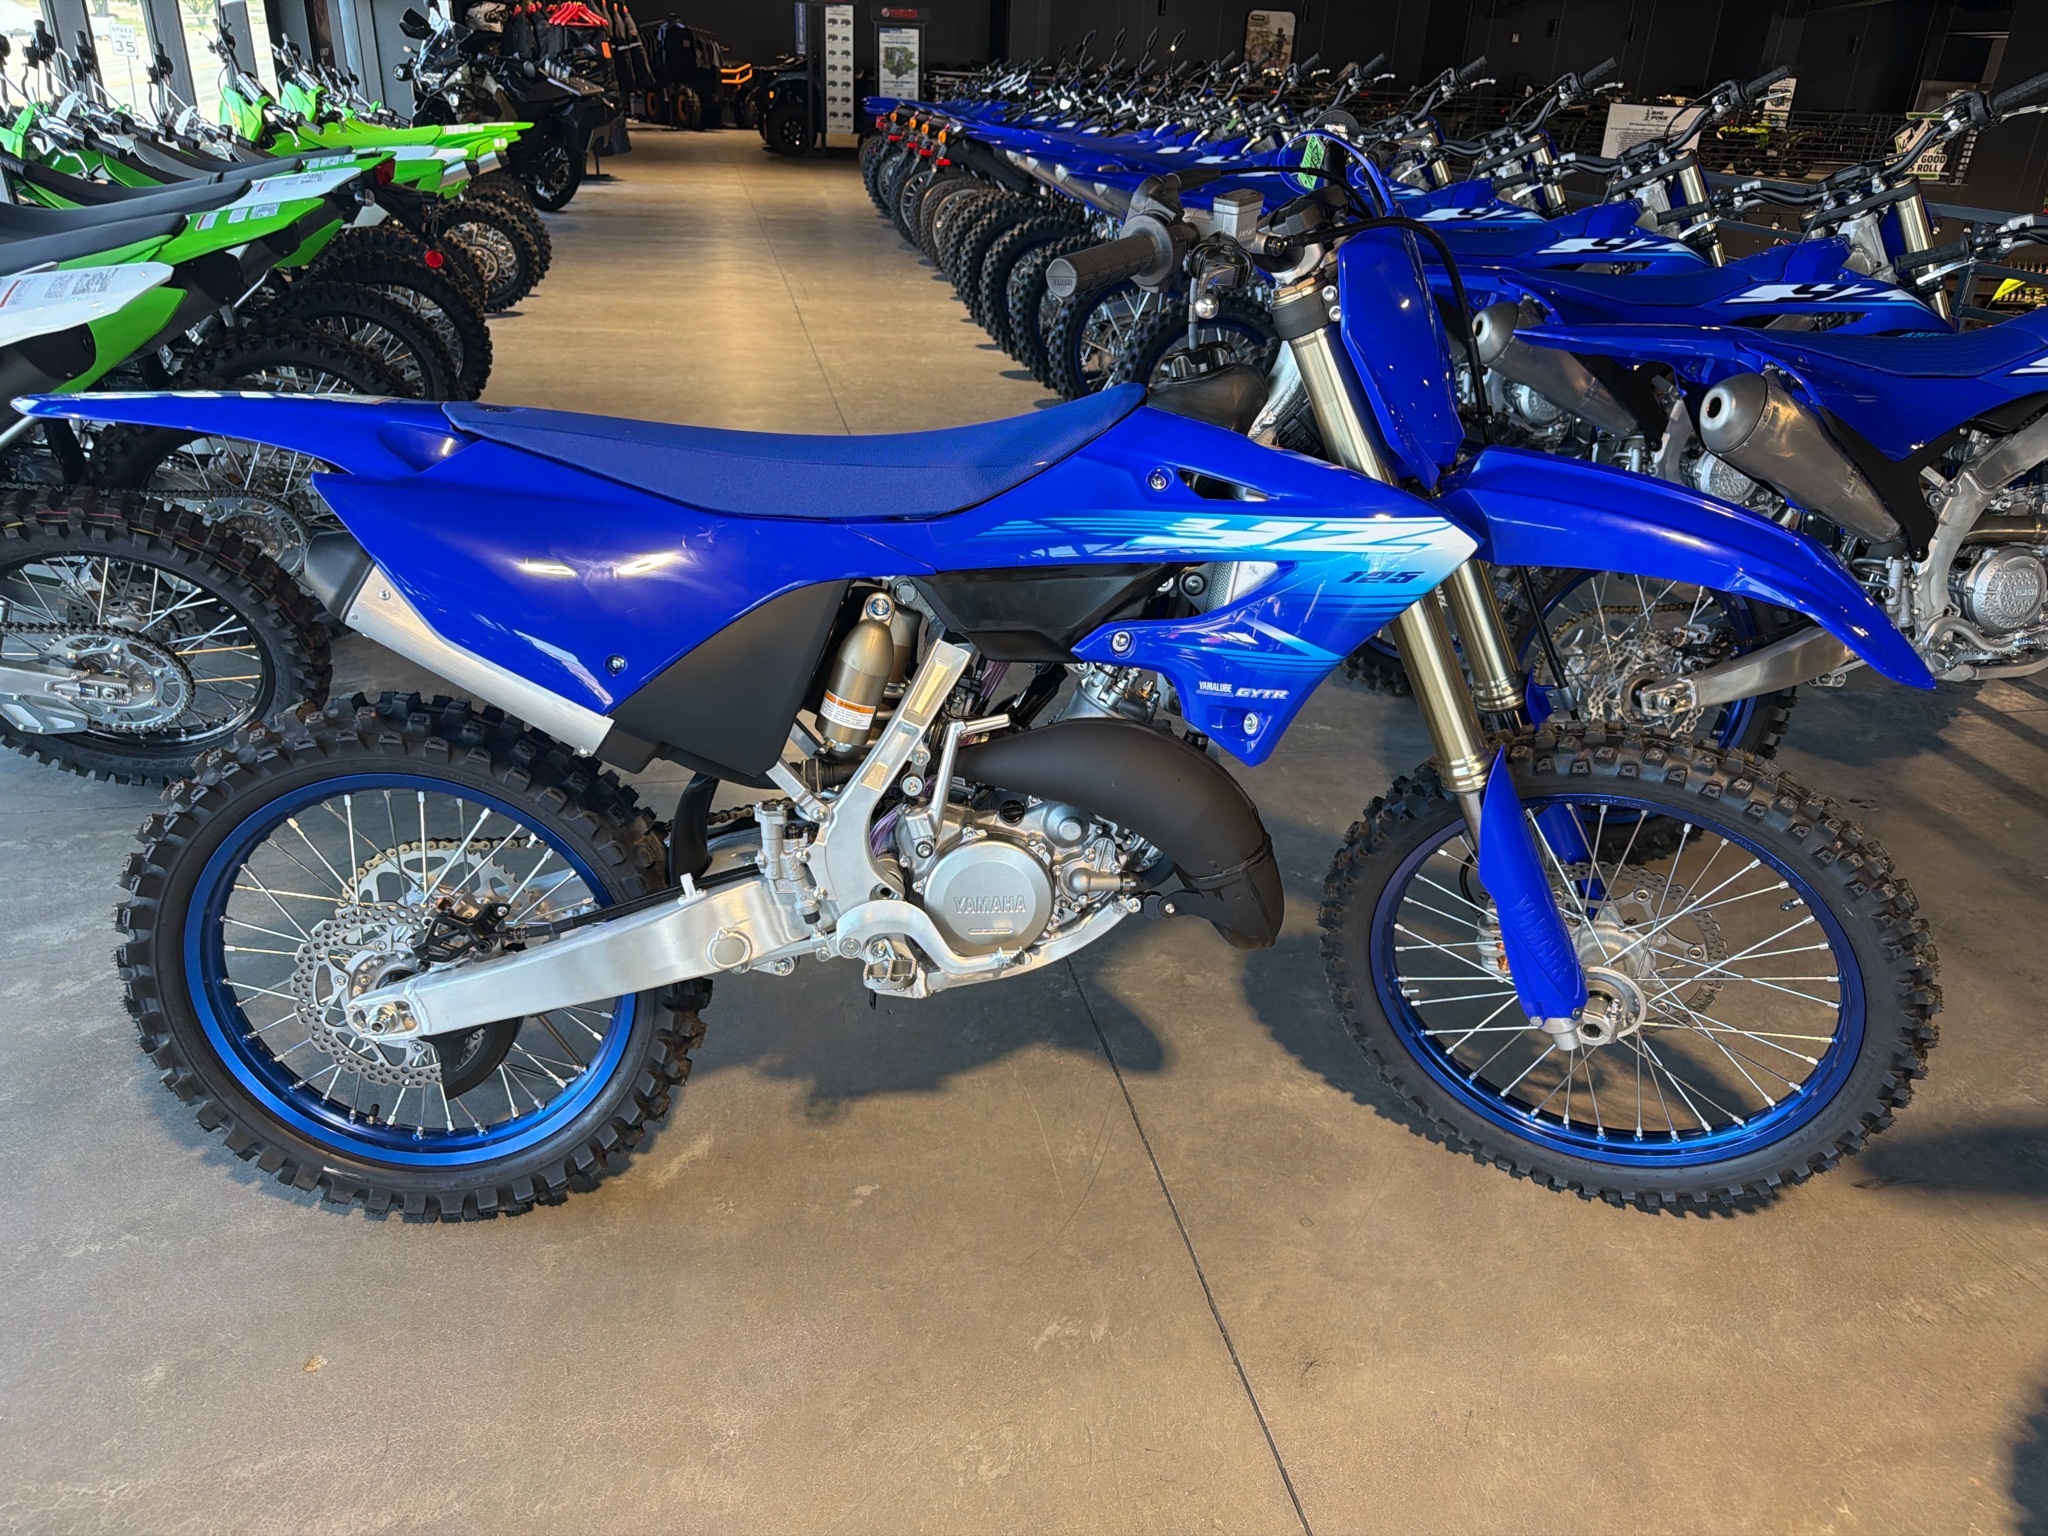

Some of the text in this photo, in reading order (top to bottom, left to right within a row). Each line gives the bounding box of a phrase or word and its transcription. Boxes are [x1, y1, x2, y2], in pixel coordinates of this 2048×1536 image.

[111, 26, 133, 34] SPEED
[115, 40, 136, 53] 35
[1921, 155, 1946, 164] GOOD
[1339, 570, 1425, 584] 125
[1198, 681, 1290, 700] YAMALUBE GYTR
[953, 894, 1027, 915] YAMAHA
